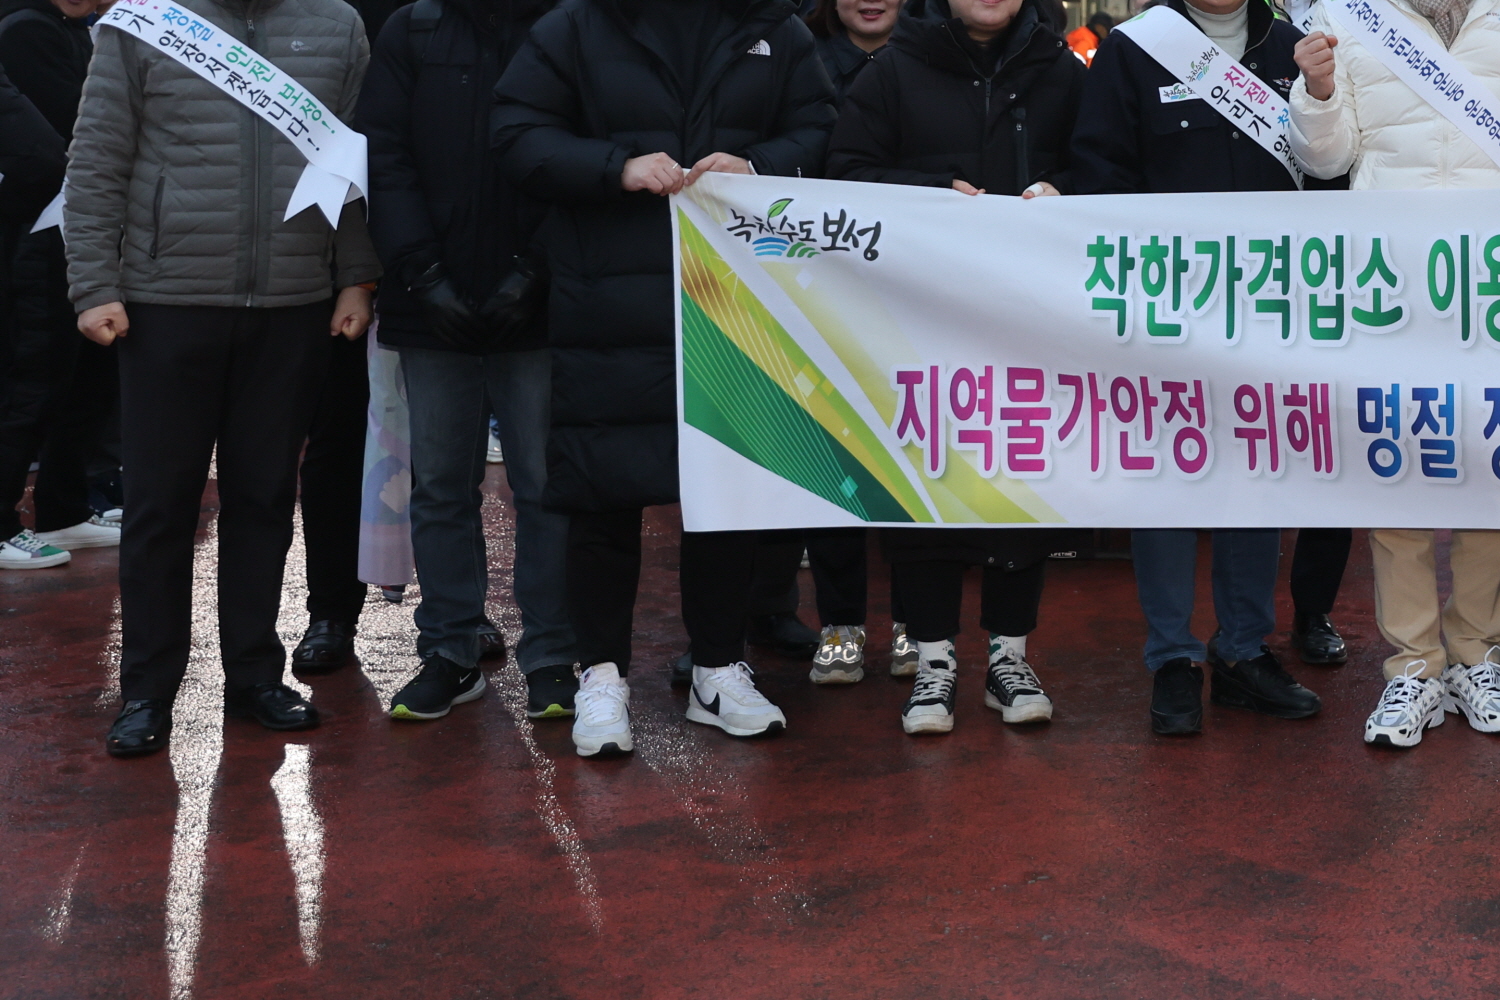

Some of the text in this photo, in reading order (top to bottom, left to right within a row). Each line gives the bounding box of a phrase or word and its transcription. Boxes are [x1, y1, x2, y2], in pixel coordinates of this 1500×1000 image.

[106, 8, 320, 152] 리가 앞장서겠습니다!
[1201, 46, 1220, 65] 보성
[1381, 28, 1465, 102] 군민문화운동
[278, 83, 336, 134] 보성!
[1210, 85, 1272, 137] 우리가
[727, 207, 881, 261] 녹차수도 보성
[1086, 234, 1403, 341] 착한가격업소
[896, 364, 1209, 475] 지역물가안정
[1234, 384, 1334, 474] 위해
[1358, 384, 1460, 479] 명절
